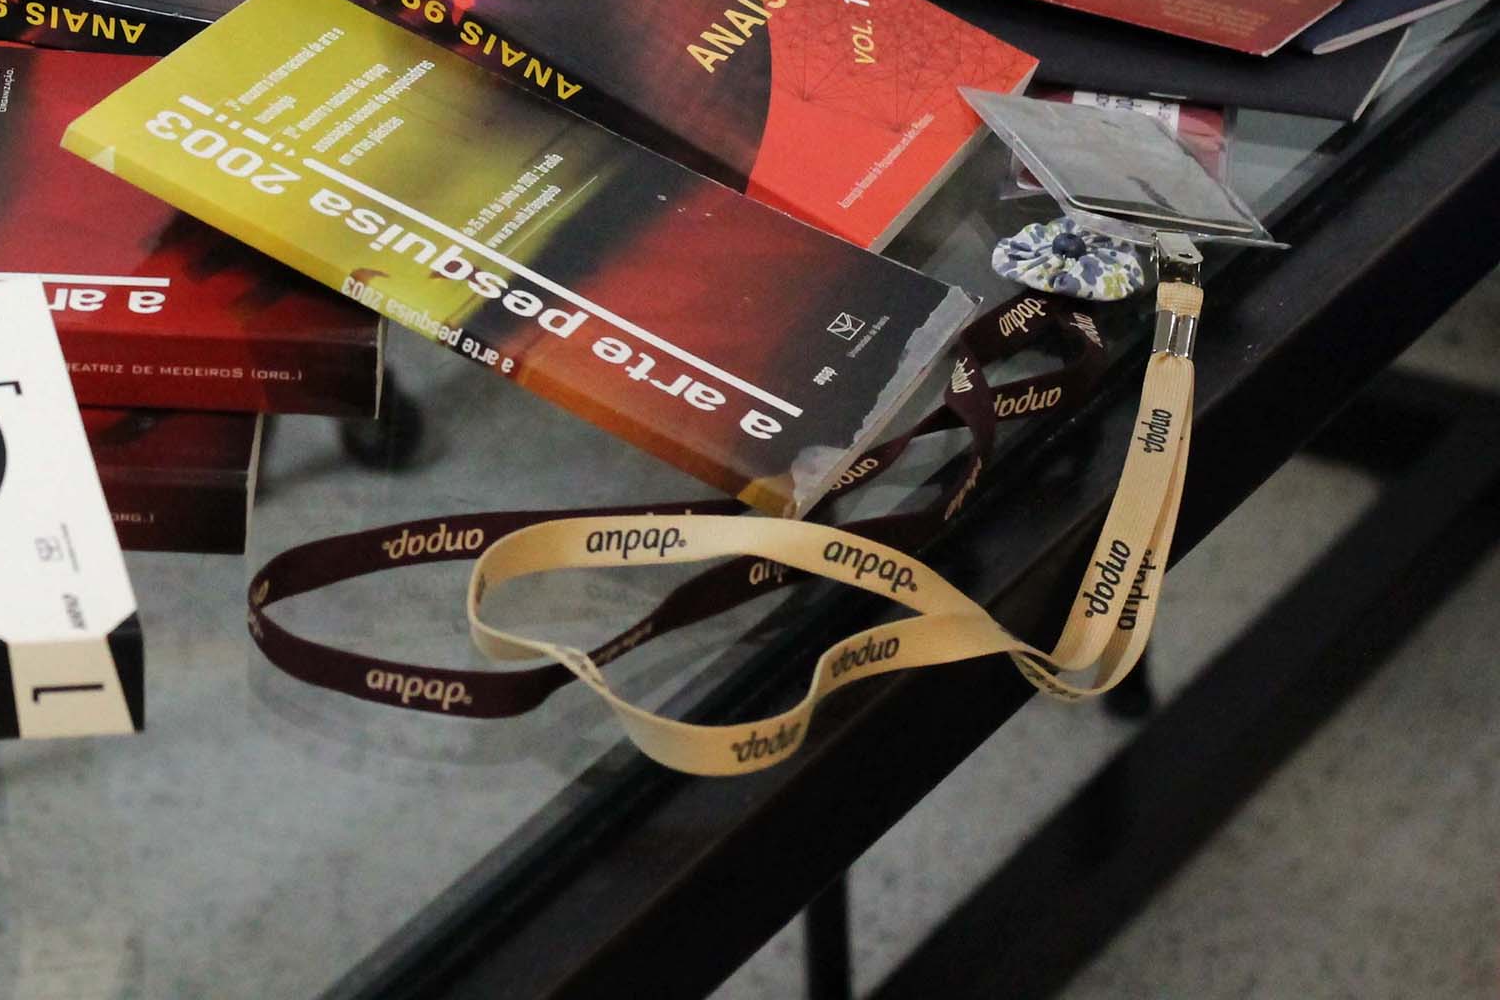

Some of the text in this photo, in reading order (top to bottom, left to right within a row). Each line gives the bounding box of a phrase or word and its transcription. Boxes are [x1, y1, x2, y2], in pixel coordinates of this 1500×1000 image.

[26, 1, 147, 44] ANAIS
[853, 18, 877, 65] VOL.
[459, 21, 583, 101] ANAIS
[144, 109, 301, 195] 2003
[308, 187, 591, 340] pesquisa
[49, 288, 107, 312] ar
[128, 290, 166, 314] a
[341, 277, 514, 376] a arte pesquisa 2003
[132, 365, 153, 375] DE
[160, 366, 244, 379] MEDEIROS
[590, 336, 727, 412] arte
[739, 407, 784, 441] a
